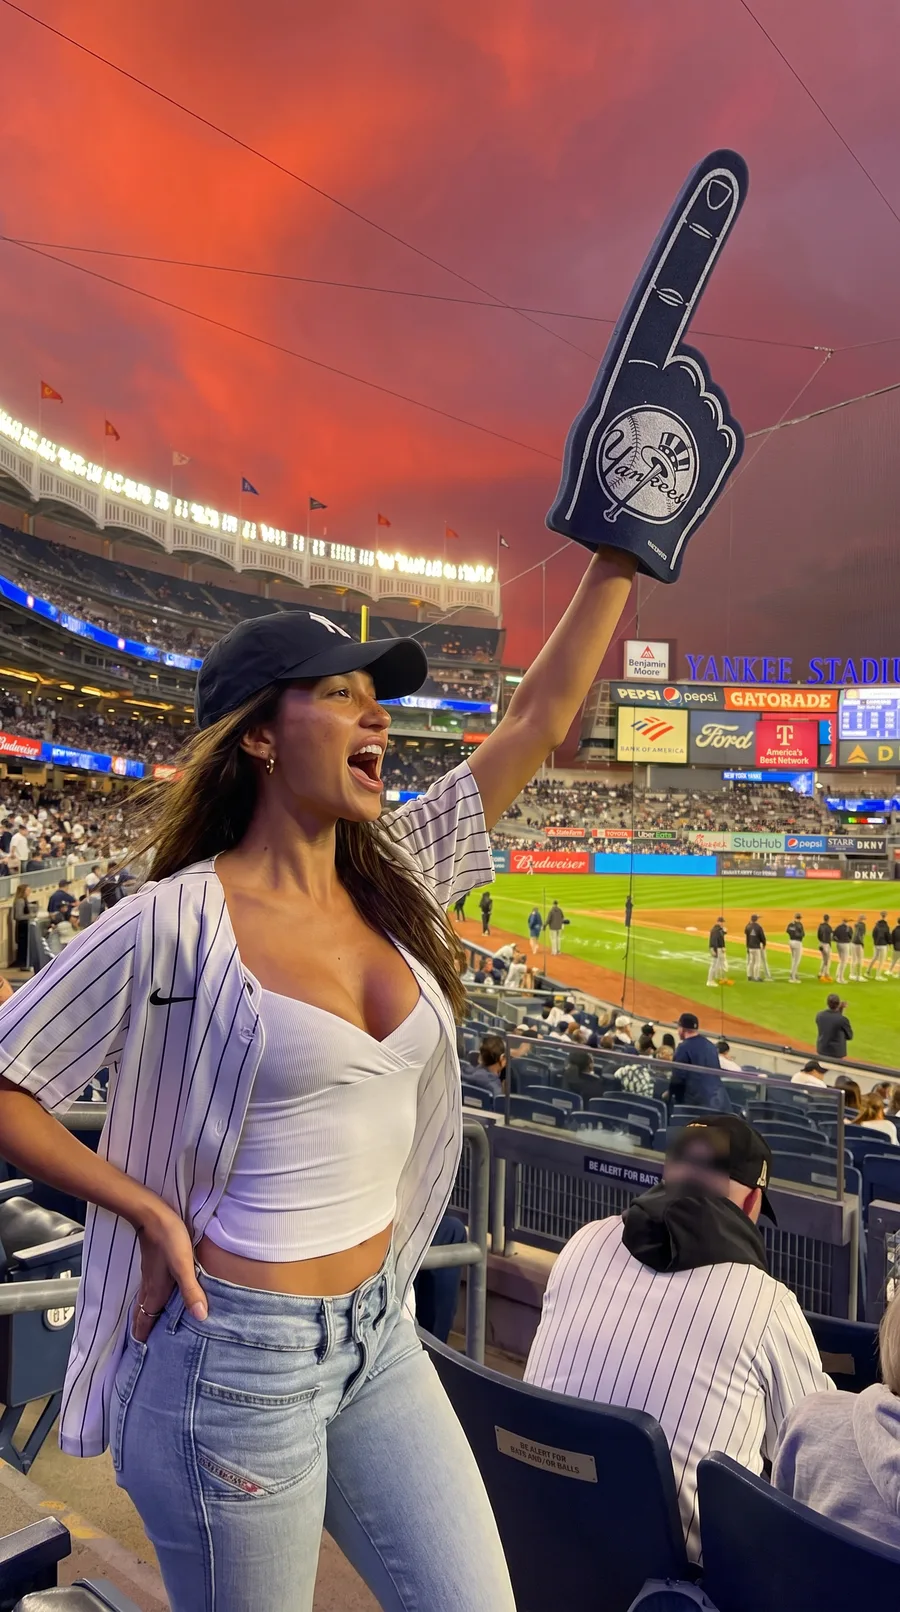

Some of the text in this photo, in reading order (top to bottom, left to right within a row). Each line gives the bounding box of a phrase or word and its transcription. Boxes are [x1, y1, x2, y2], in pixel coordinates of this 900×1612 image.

[602, 429, 686, 504] Yankees
[629, 659, 666, 669] Benjamin
[685, 654, 793, 684] YANKEE
[634, 668, 660, 676] Moore
[617, 688, 718, 703] PEPSI pepsi
[730, 692, 832, 708] GATORADE
[695, 723, 754, 749] Ford
[776, 725, 793, 746] T
[766, 748, 803, 756] America's
[760, 756, 809, 765] Best Network
[637, 831, 673, 839] Uber Eats
[734, 837, 782, 849] StubHub
[799, 840, 823, 849] pepsi
[828, 838, 854, 846] STARR
[857, 841, 884, 849] DKNY
[514, 854, 585, 869] Budweiser
[854, 871, 884, 880] DKNY
[589, 1160, 659, 1185] BE ALERT FOR BATS
[520, 1442, 566, 1462] BE ALERT FOR
[510, 1446, 527, 1458] BATS
[557, 1463, 580, 1474] BALLS
